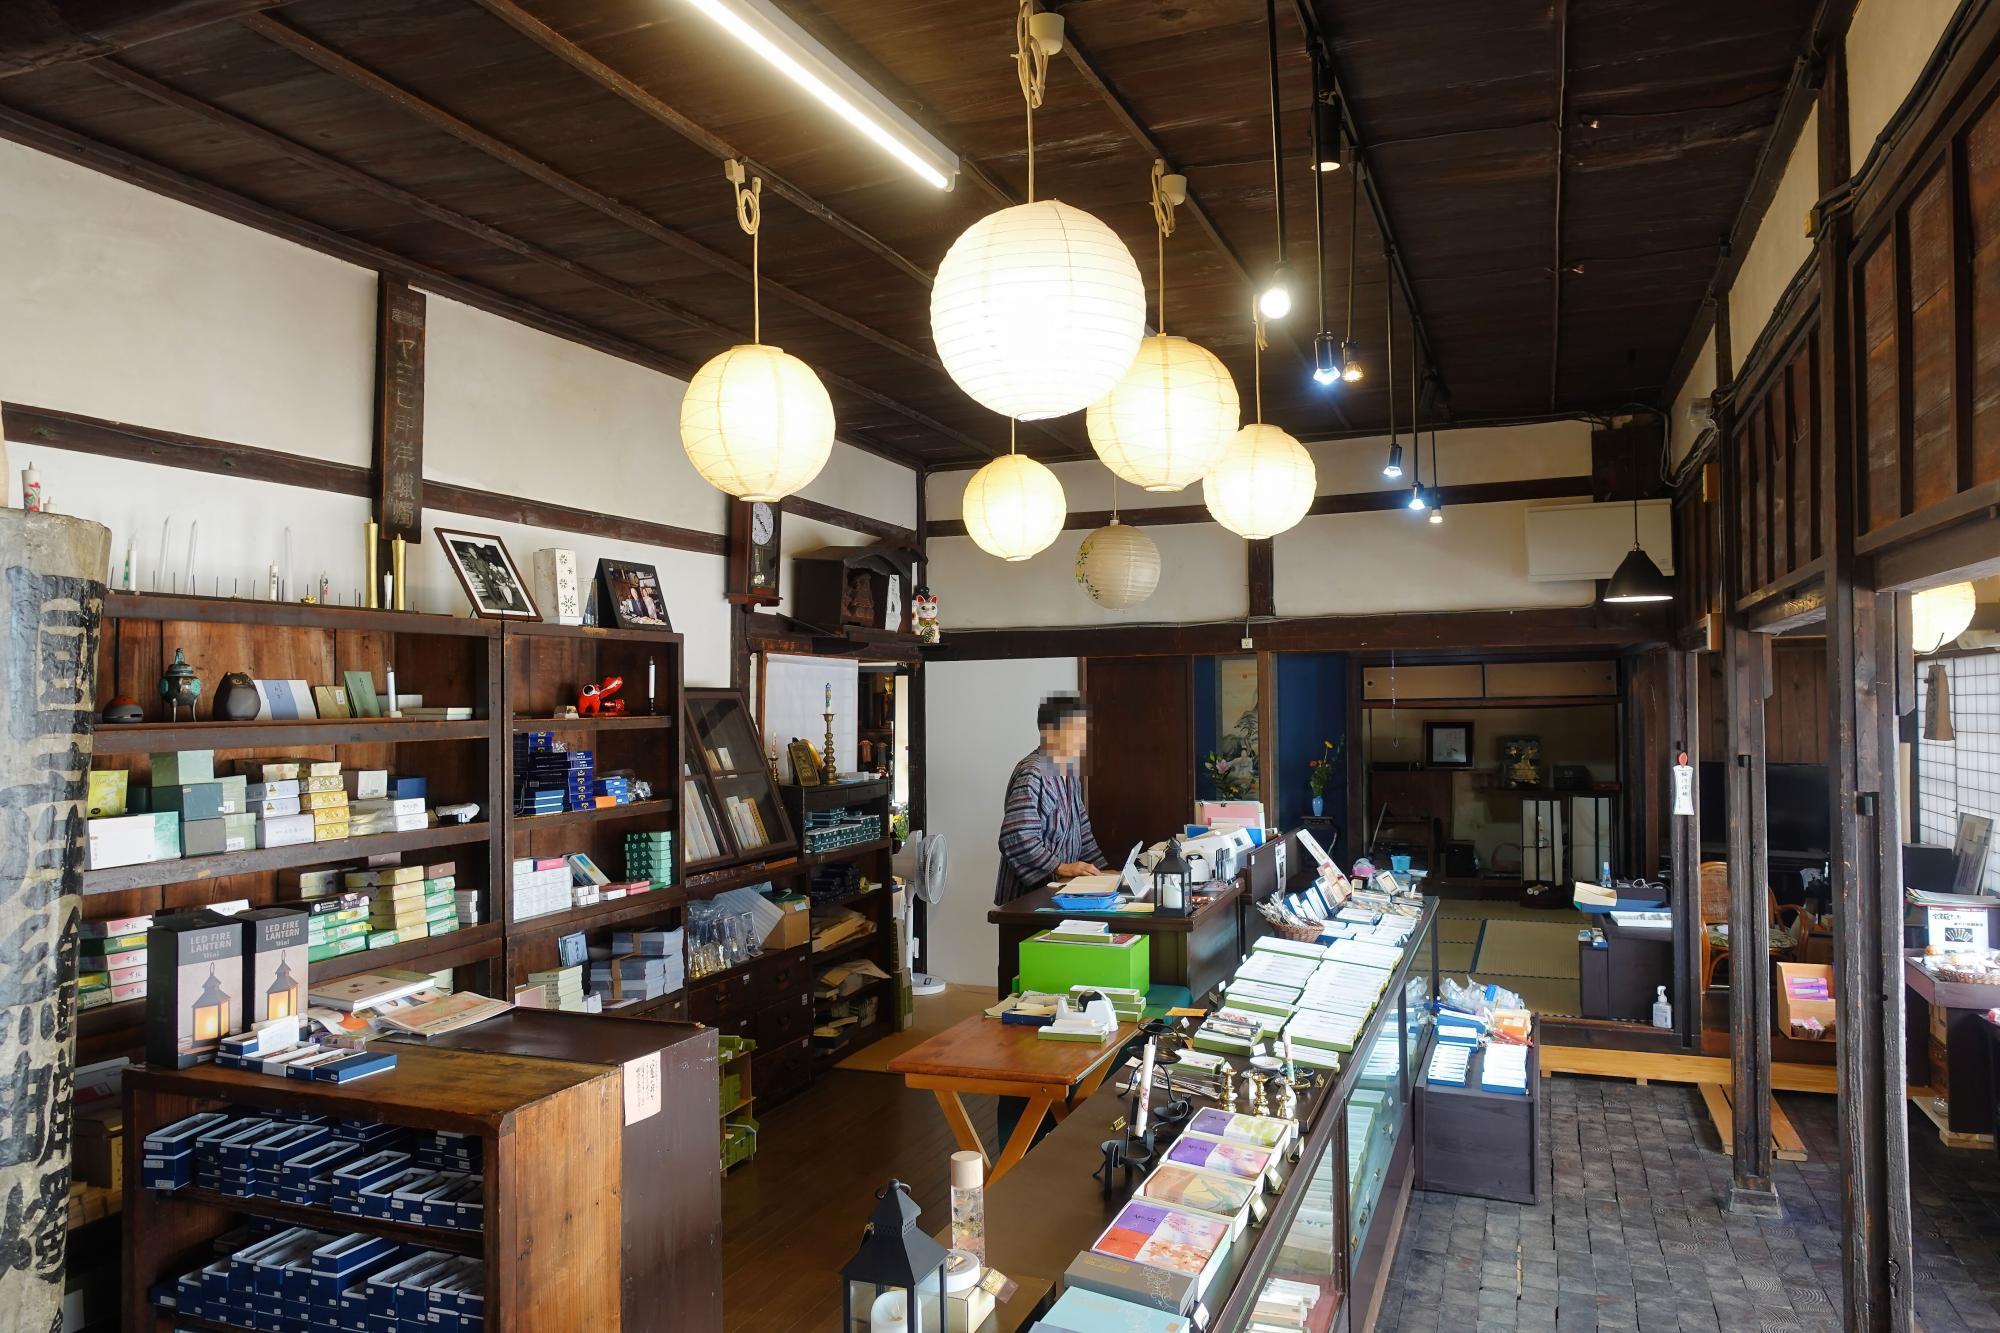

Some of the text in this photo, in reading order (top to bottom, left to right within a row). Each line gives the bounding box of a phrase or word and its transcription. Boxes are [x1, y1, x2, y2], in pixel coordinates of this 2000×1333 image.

[265, 920, 300, 934] LED FIRE
[265, 927, 300, 941] LANTERN
[190, 931, 232, 945] LED FIRE
[190, 939, 232, 953] LANTERN
